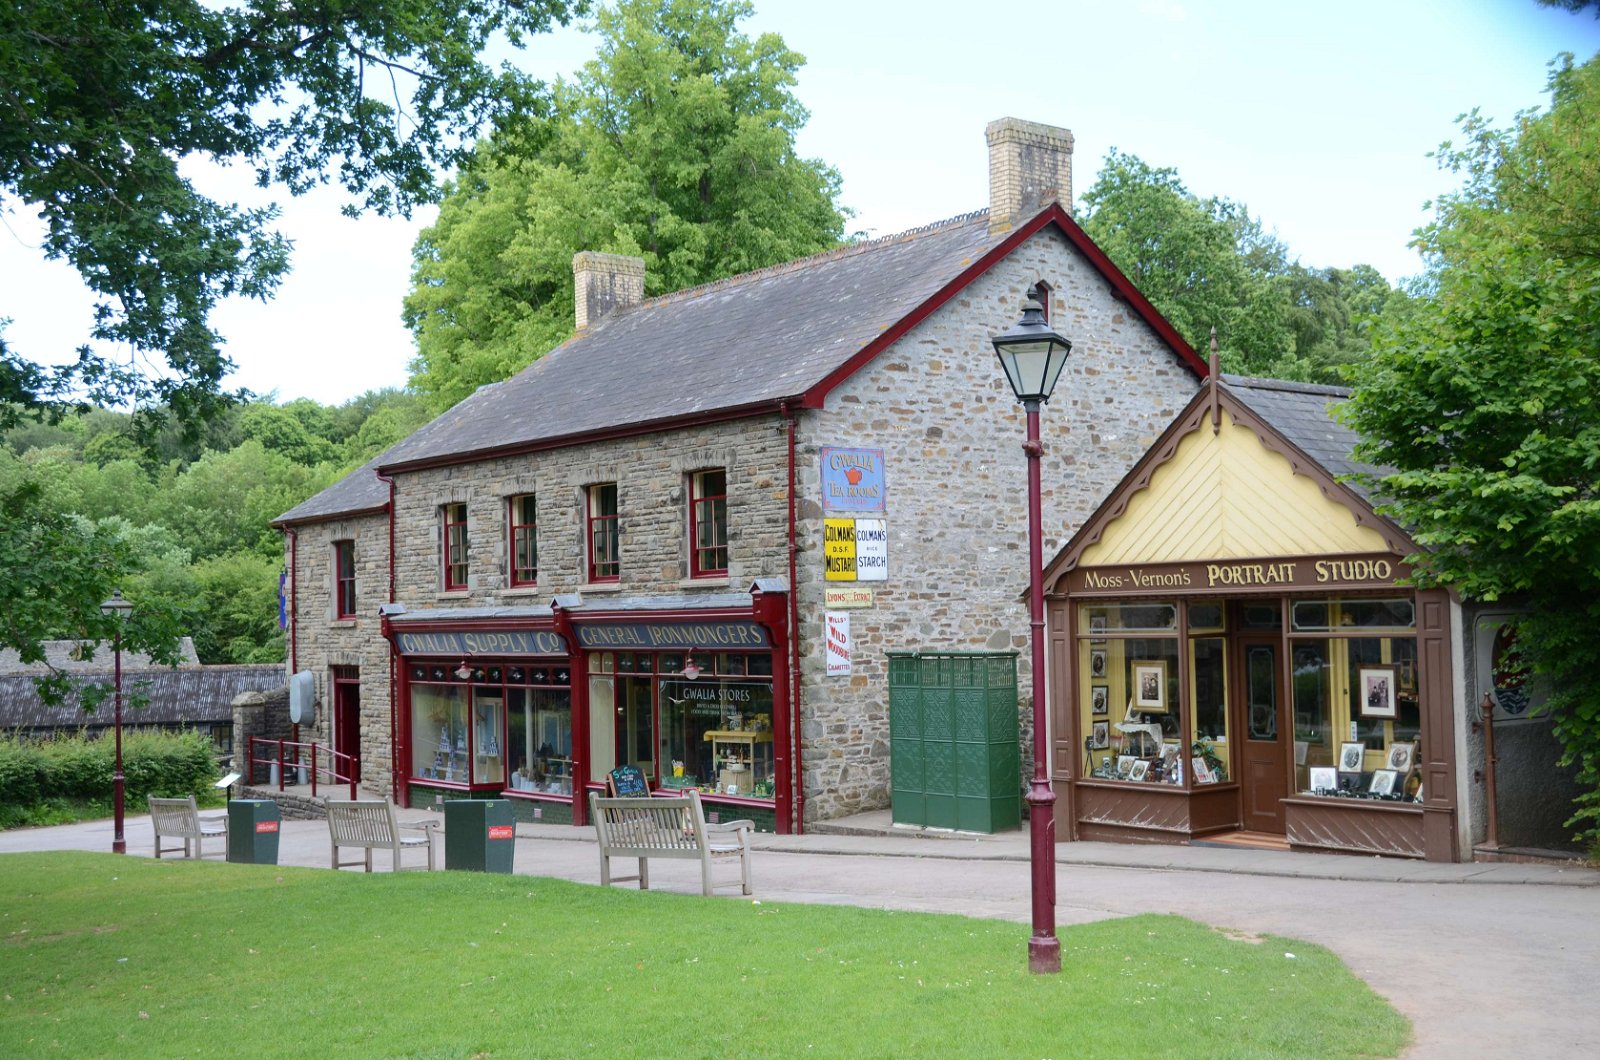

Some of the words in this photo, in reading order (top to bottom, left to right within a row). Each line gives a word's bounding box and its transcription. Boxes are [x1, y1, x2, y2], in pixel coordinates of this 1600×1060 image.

[830, 453, 874, 473] GWALIA
[828, 481, 844, 497] TEA
[846, 484, 880, 498] ROOMS
[825, 555, 855, 572] MUSTARD
[858, 556, 886, 567] STARCH
[1207, 563, 1296, 587] PORTRAIT
[1315, 560, 1392, 582] STUDIO
[402, 633, 460, 653] GWALIA
[464, 632, 529, 653] SUPPLY
[580, 626, 646, 646] GENERAL
[648, 624, 762, 646] IRONMONGERS
[683, 688, 716, 700] GWALIA
[718, 689, 751, 702] STORES
